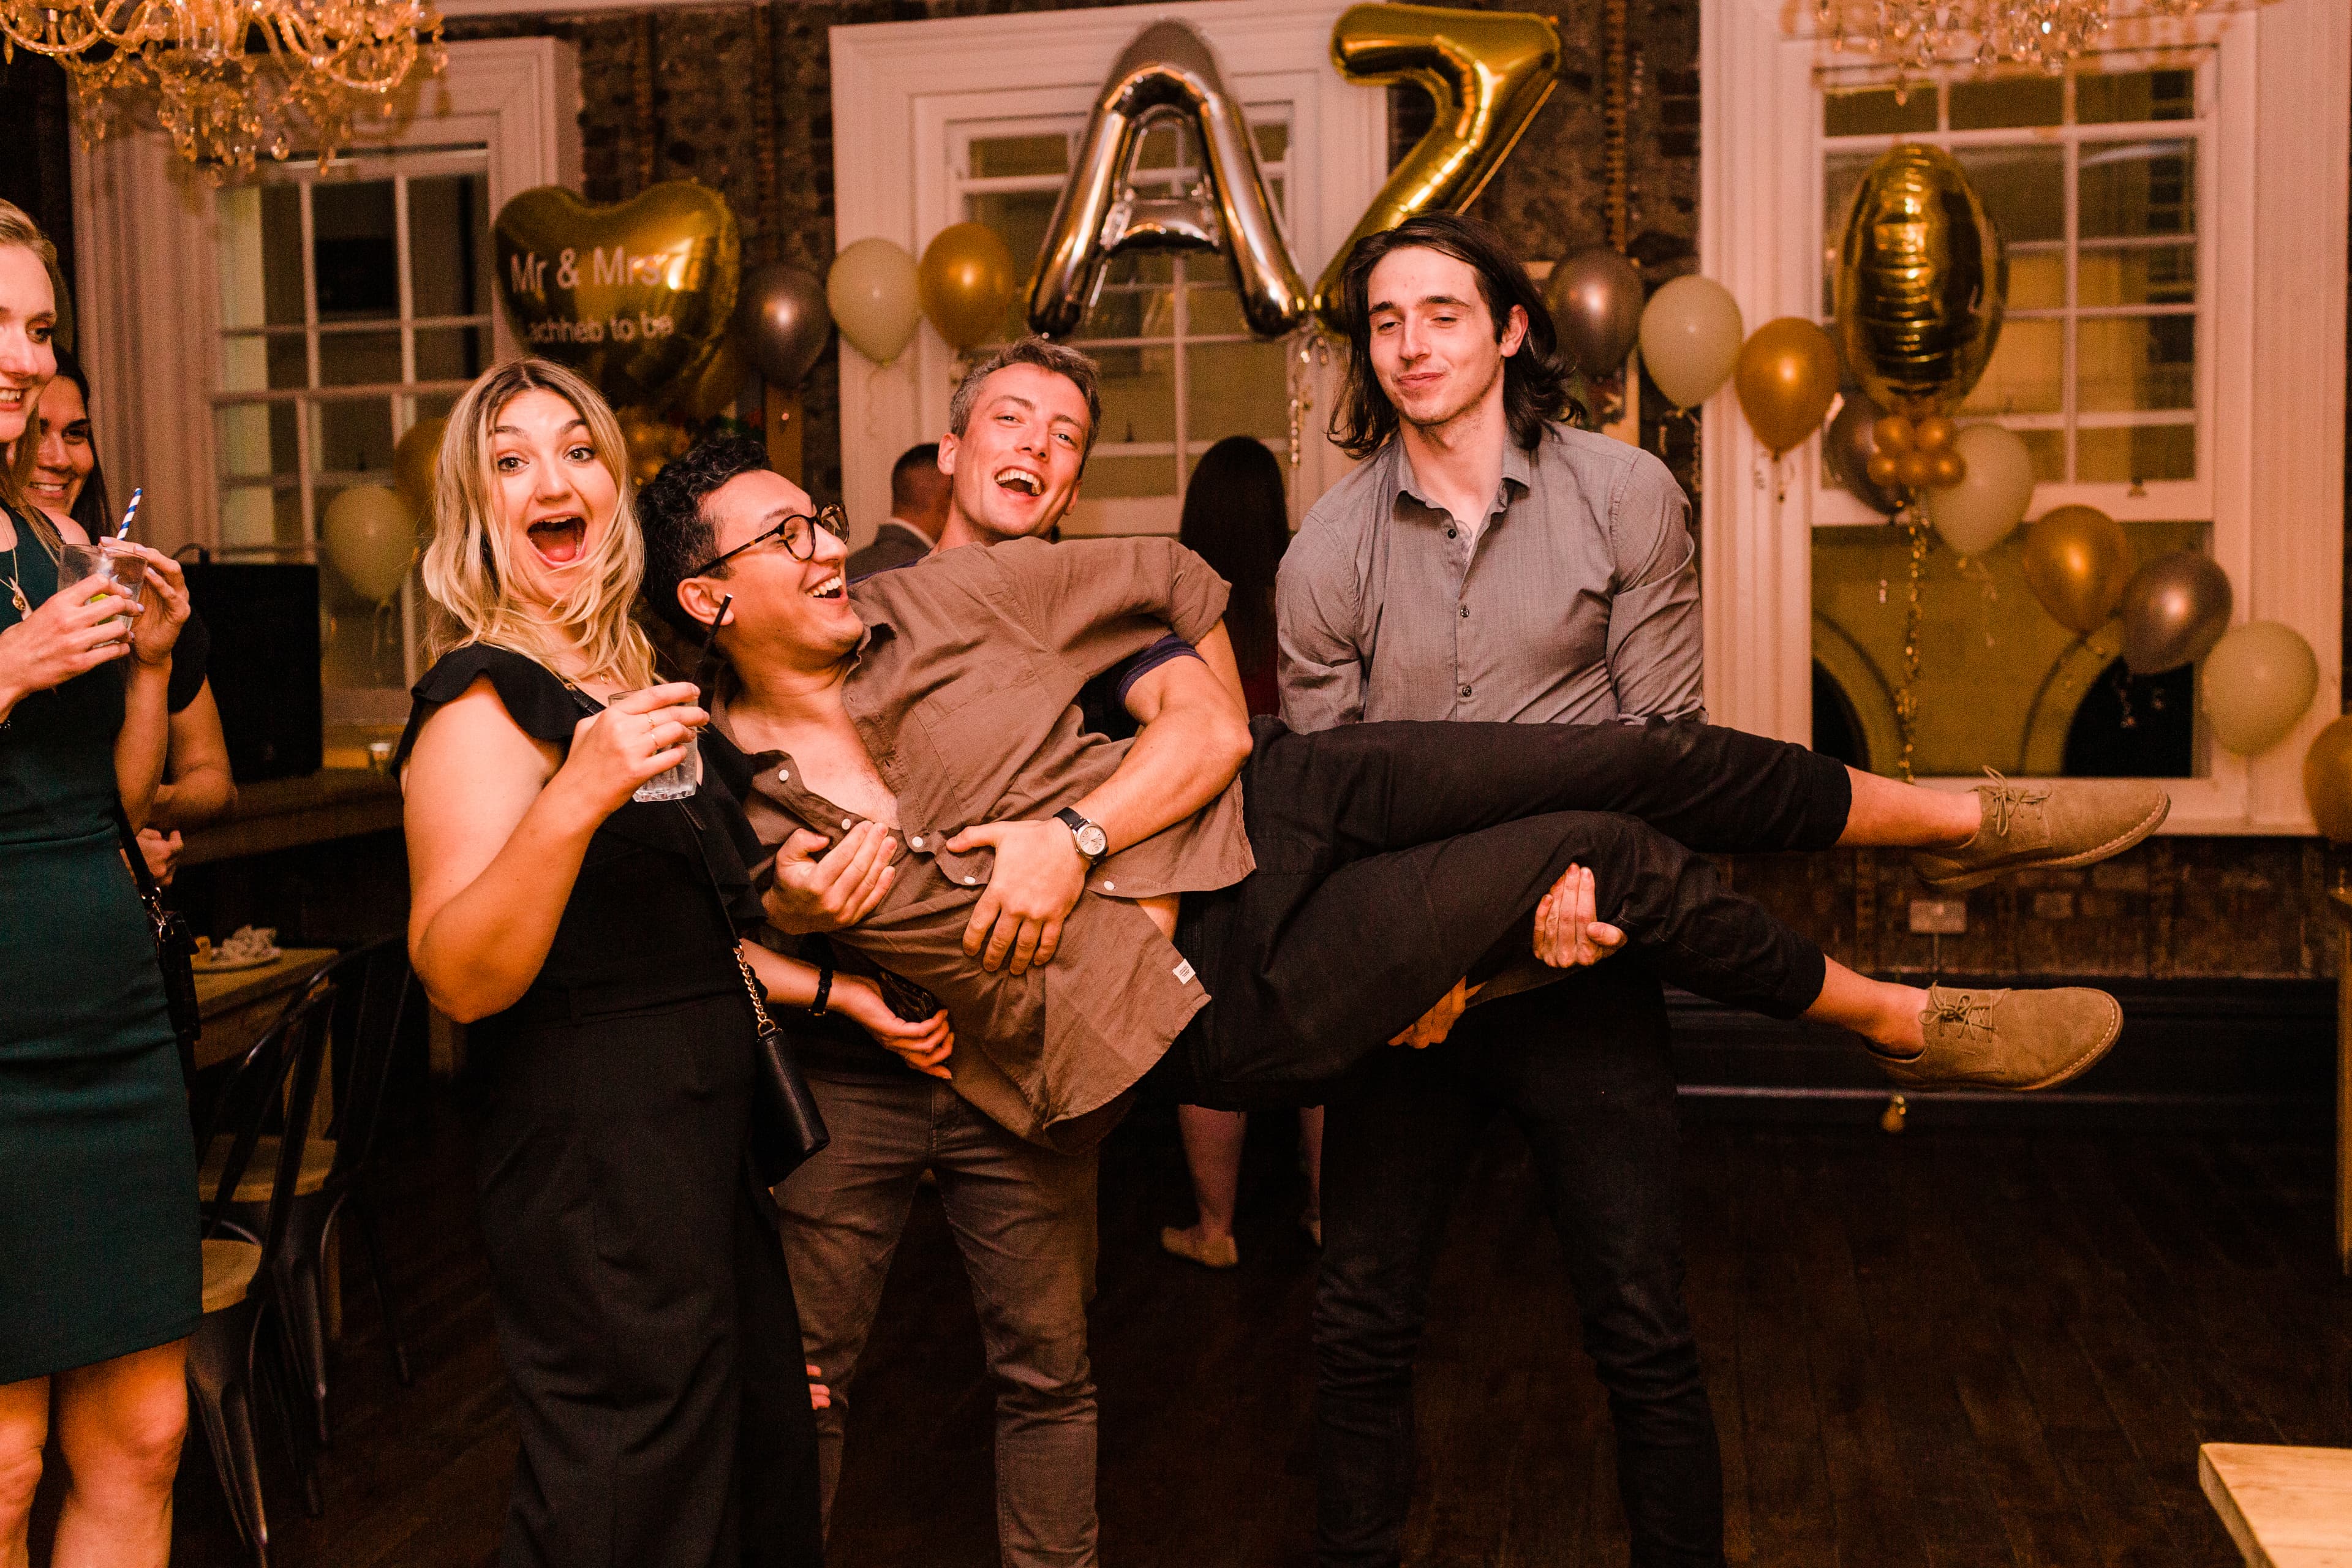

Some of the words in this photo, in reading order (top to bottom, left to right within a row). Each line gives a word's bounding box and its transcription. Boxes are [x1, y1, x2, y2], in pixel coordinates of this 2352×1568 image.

[510, 252, 548, 293] Mr
[557, 247, 580, 289] &
[593, 246, 663, 285] Mrs
[610, 317, 636, 342] to
[640, 311, 674, 339] be
